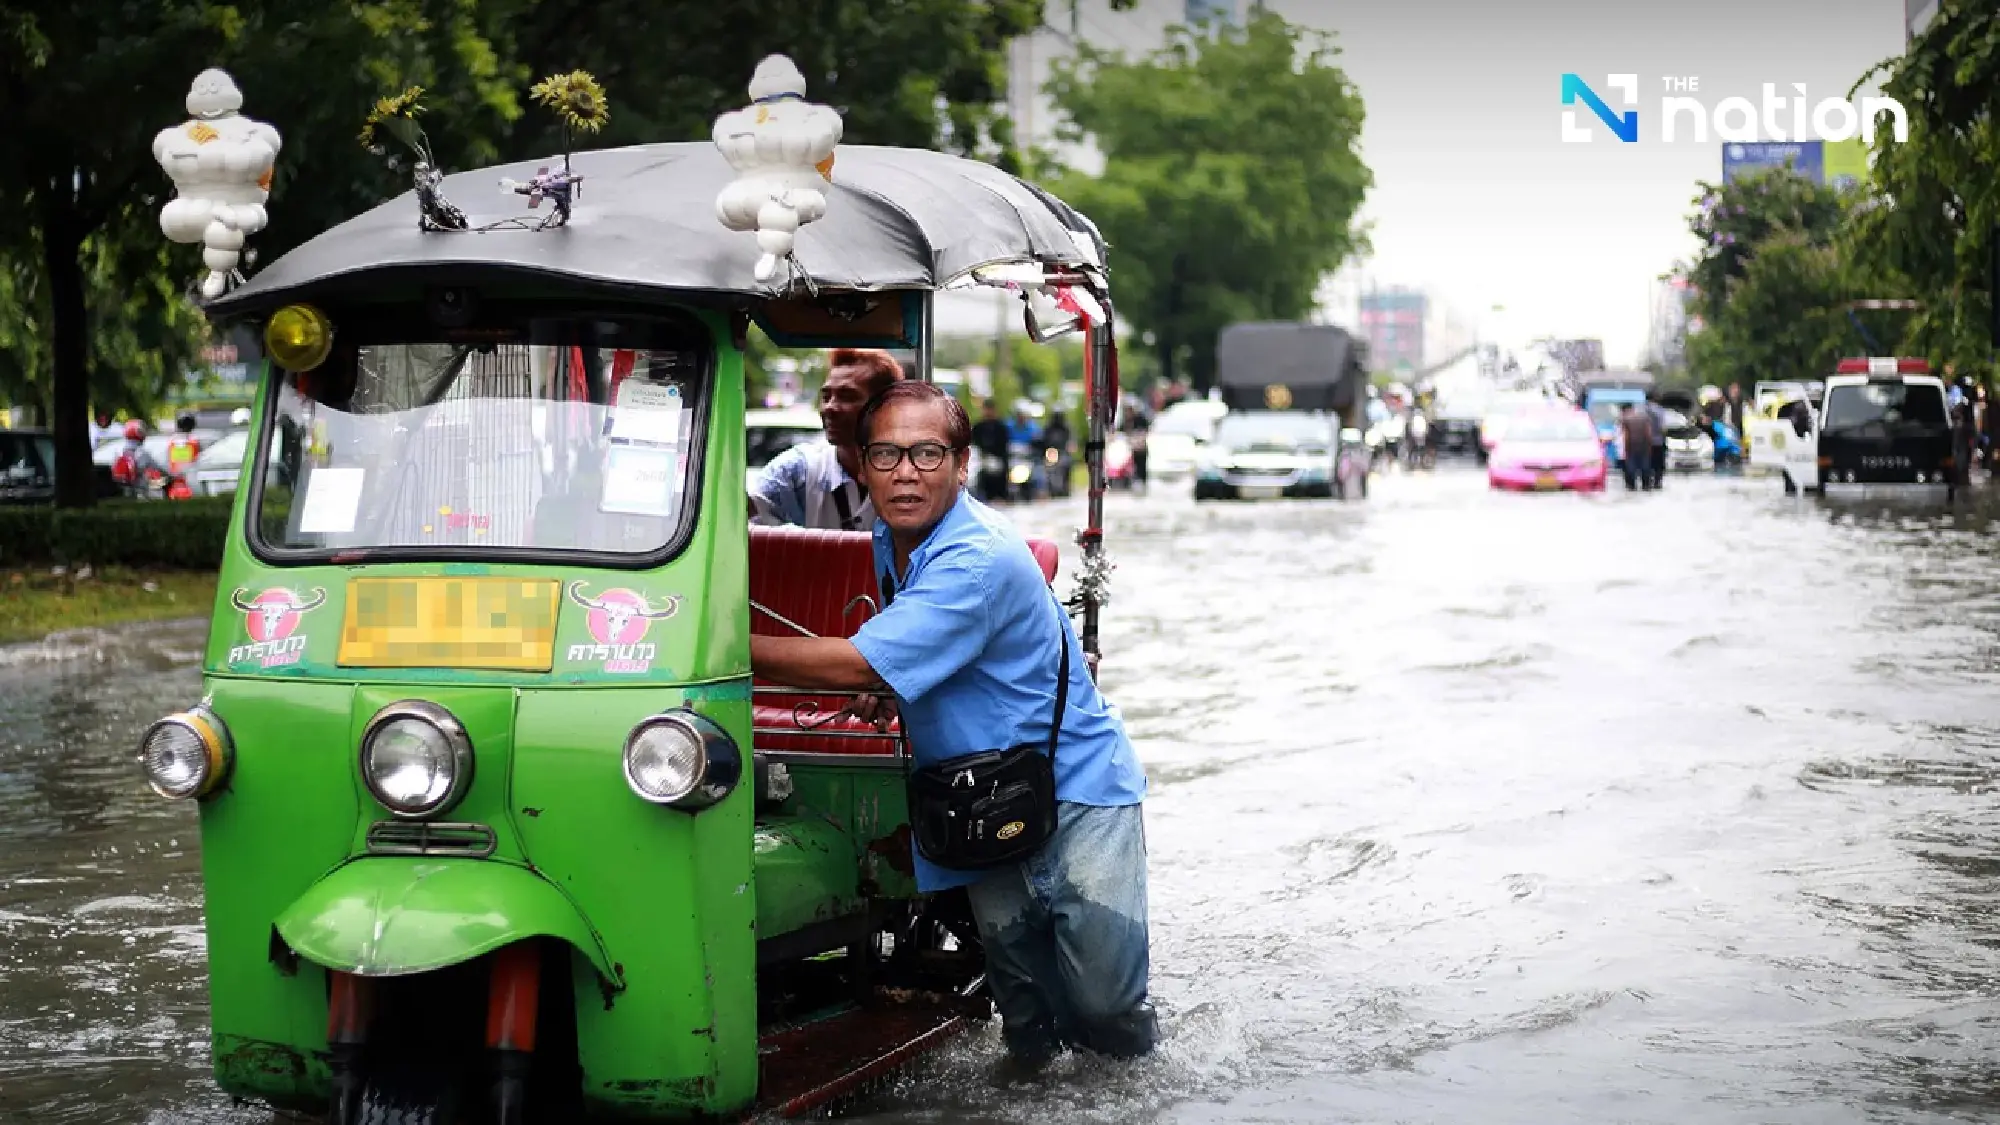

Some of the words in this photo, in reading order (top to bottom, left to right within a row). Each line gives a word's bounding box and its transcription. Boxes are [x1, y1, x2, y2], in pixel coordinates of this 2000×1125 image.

[1861, 455, 1913, 469] TOYOTA
[227, 634, 307, 665] คาราบาว
[567, 644, 656, 661] คาราบาว
